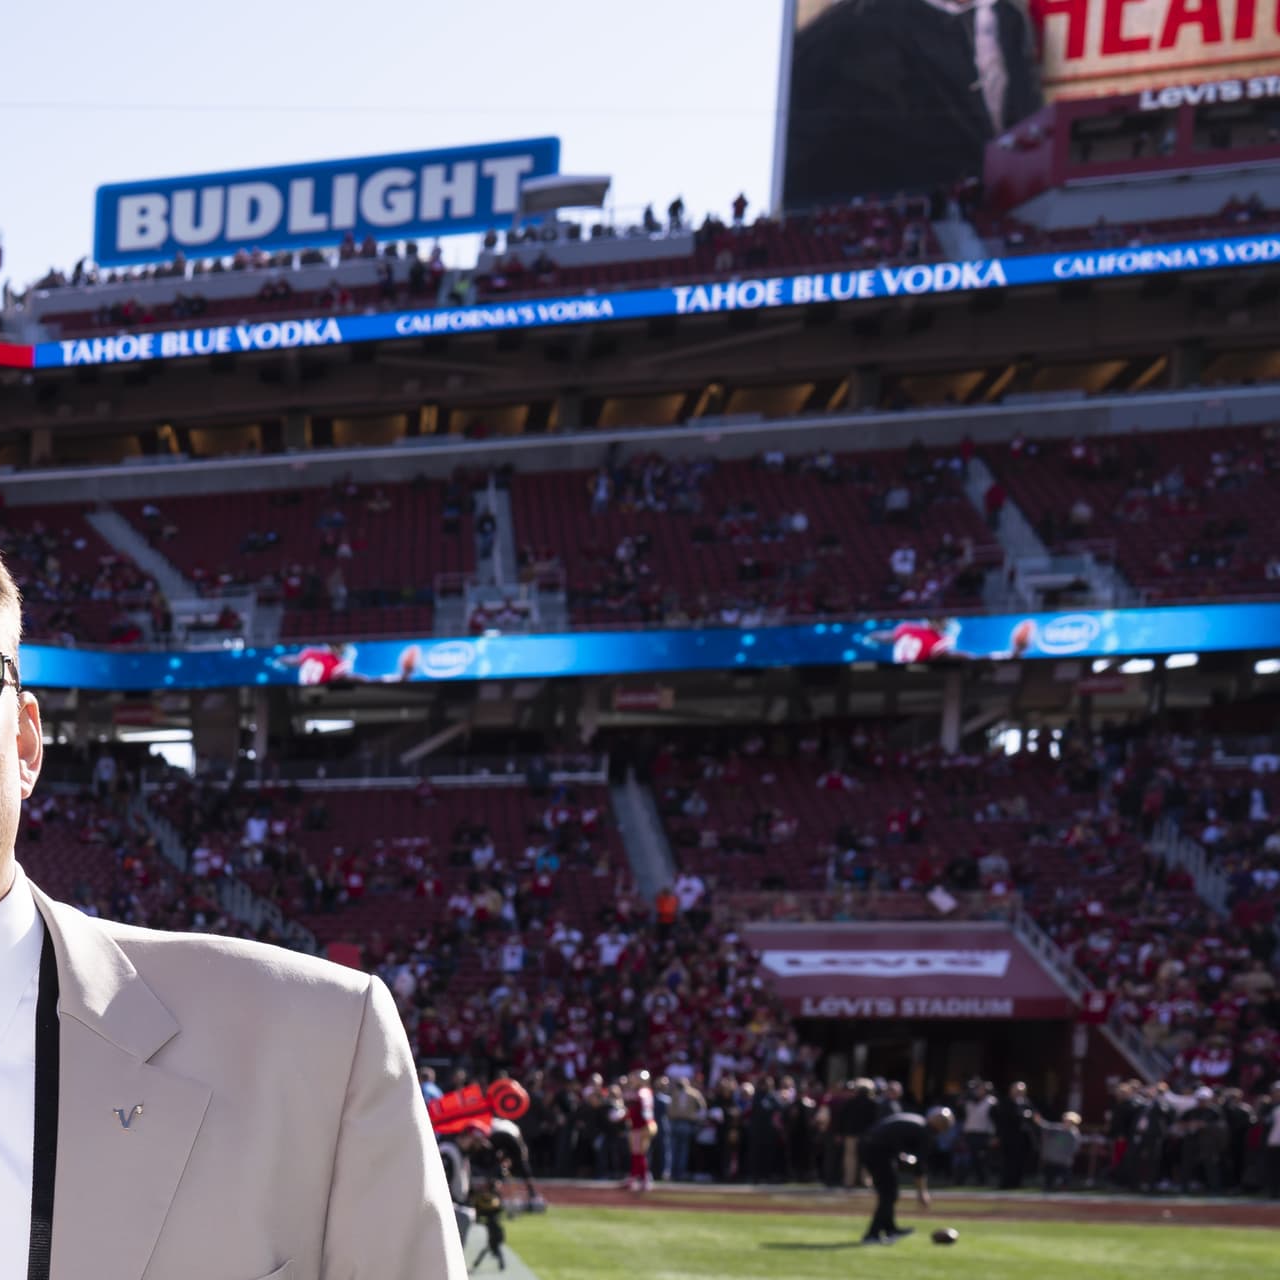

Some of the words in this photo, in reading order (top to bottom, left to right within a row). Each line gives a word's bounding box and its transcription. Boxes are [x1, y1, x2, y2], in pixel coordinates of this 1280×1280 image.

[1053, 245, 1219, 278] CALIFORNIA'S
[1224, 238, 1280, 263] VOD
[672, 277, 783, 315] TAHOE
[791, 268, 875, 304] BLUE
[880, 258, 1008, 296] VODKA
[395, 304, 536, 335] CALIFORNIA'S
[537, 298, 615, 322] VODKA
[61, 331, 155, 365] TAHOE
[160, 325, 232, 359] BLUE
[237, 317, 342, 350] VODKA
[900, 997, 1014, 1017] STADIUM
